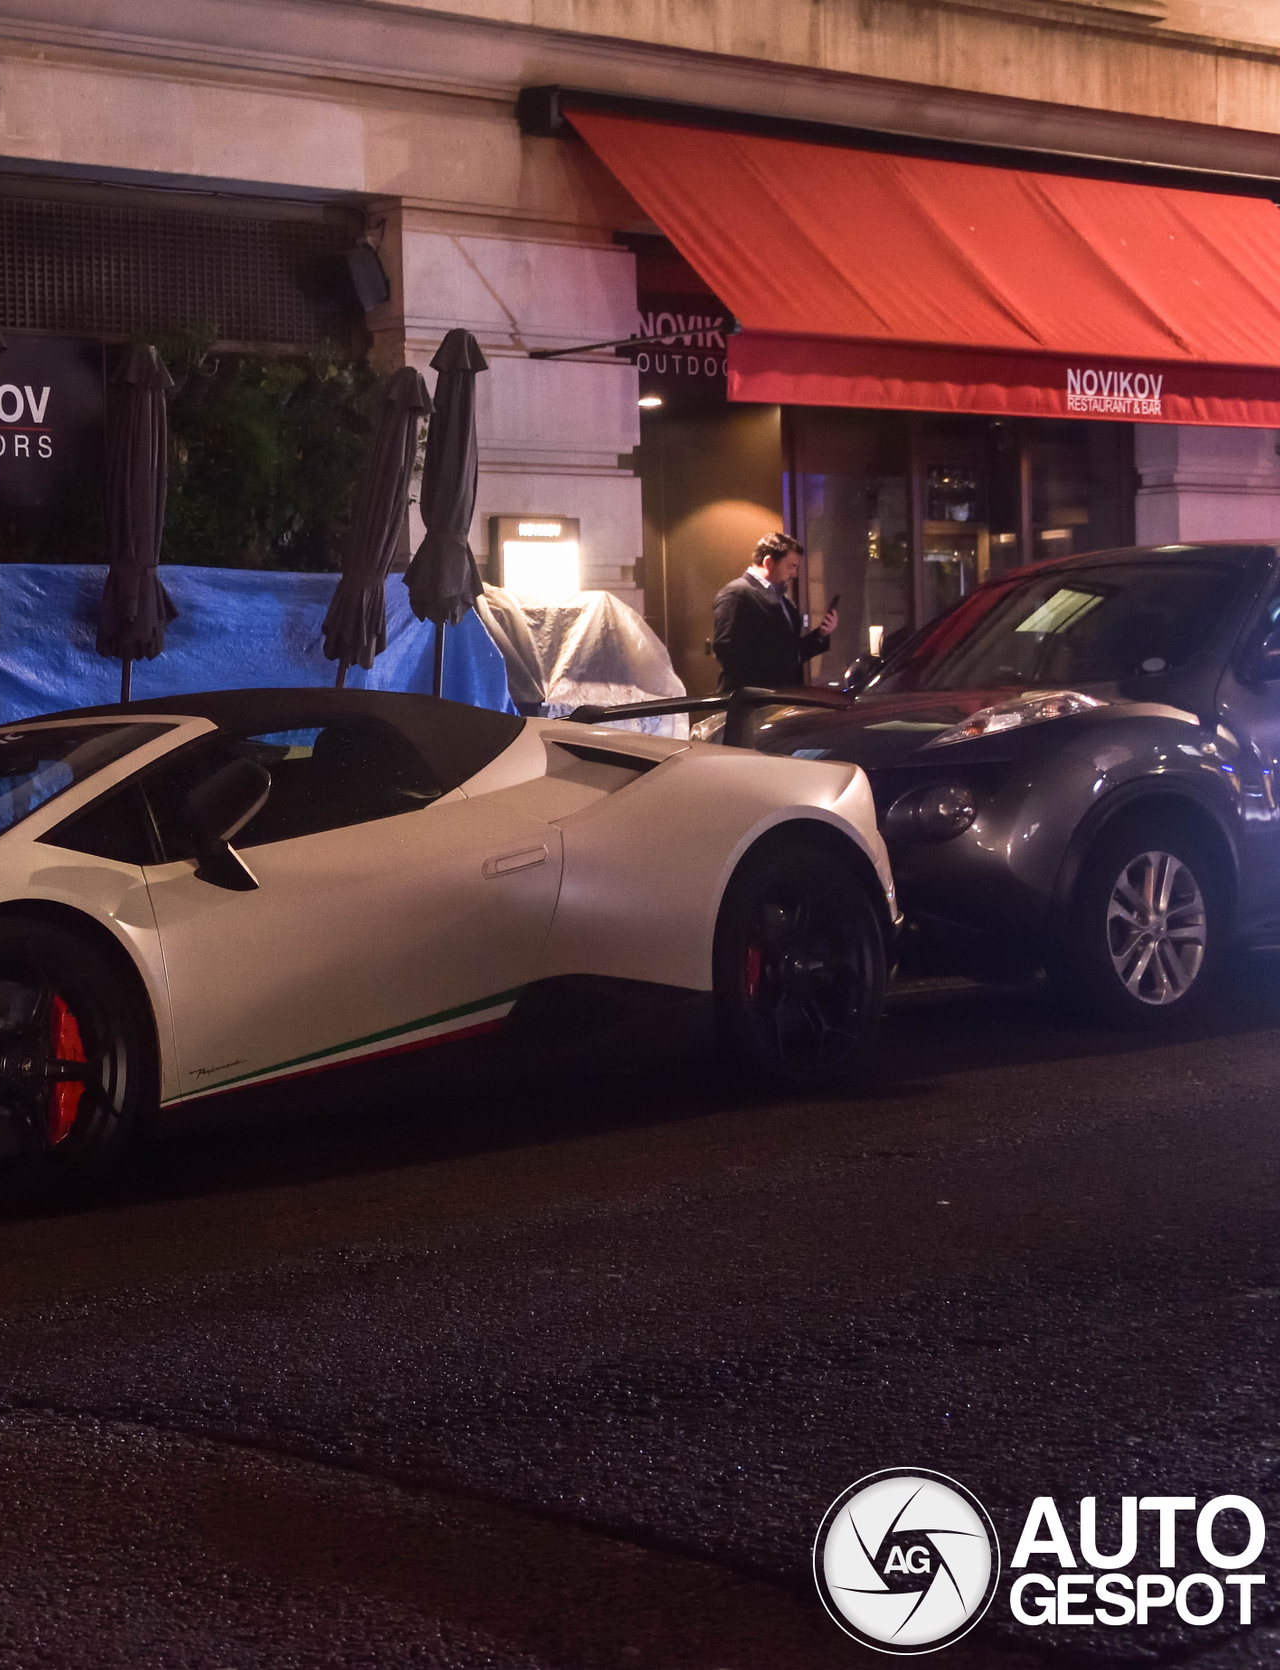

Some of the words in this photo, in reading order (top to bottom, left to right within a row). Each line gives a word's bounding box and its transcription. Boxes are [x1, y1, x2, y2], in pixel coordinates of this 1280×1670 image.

[637, 311, 725, 348] NOVIK
[636, 352, 728, 377] OUTDO
[1066, 368, 1163, 400] NOVIKOV
[1067, 397, 1132, 413] RESTAURANT
[1133, 401, 1141, 415] &
[1141, 401, 1162, 415] BAR
